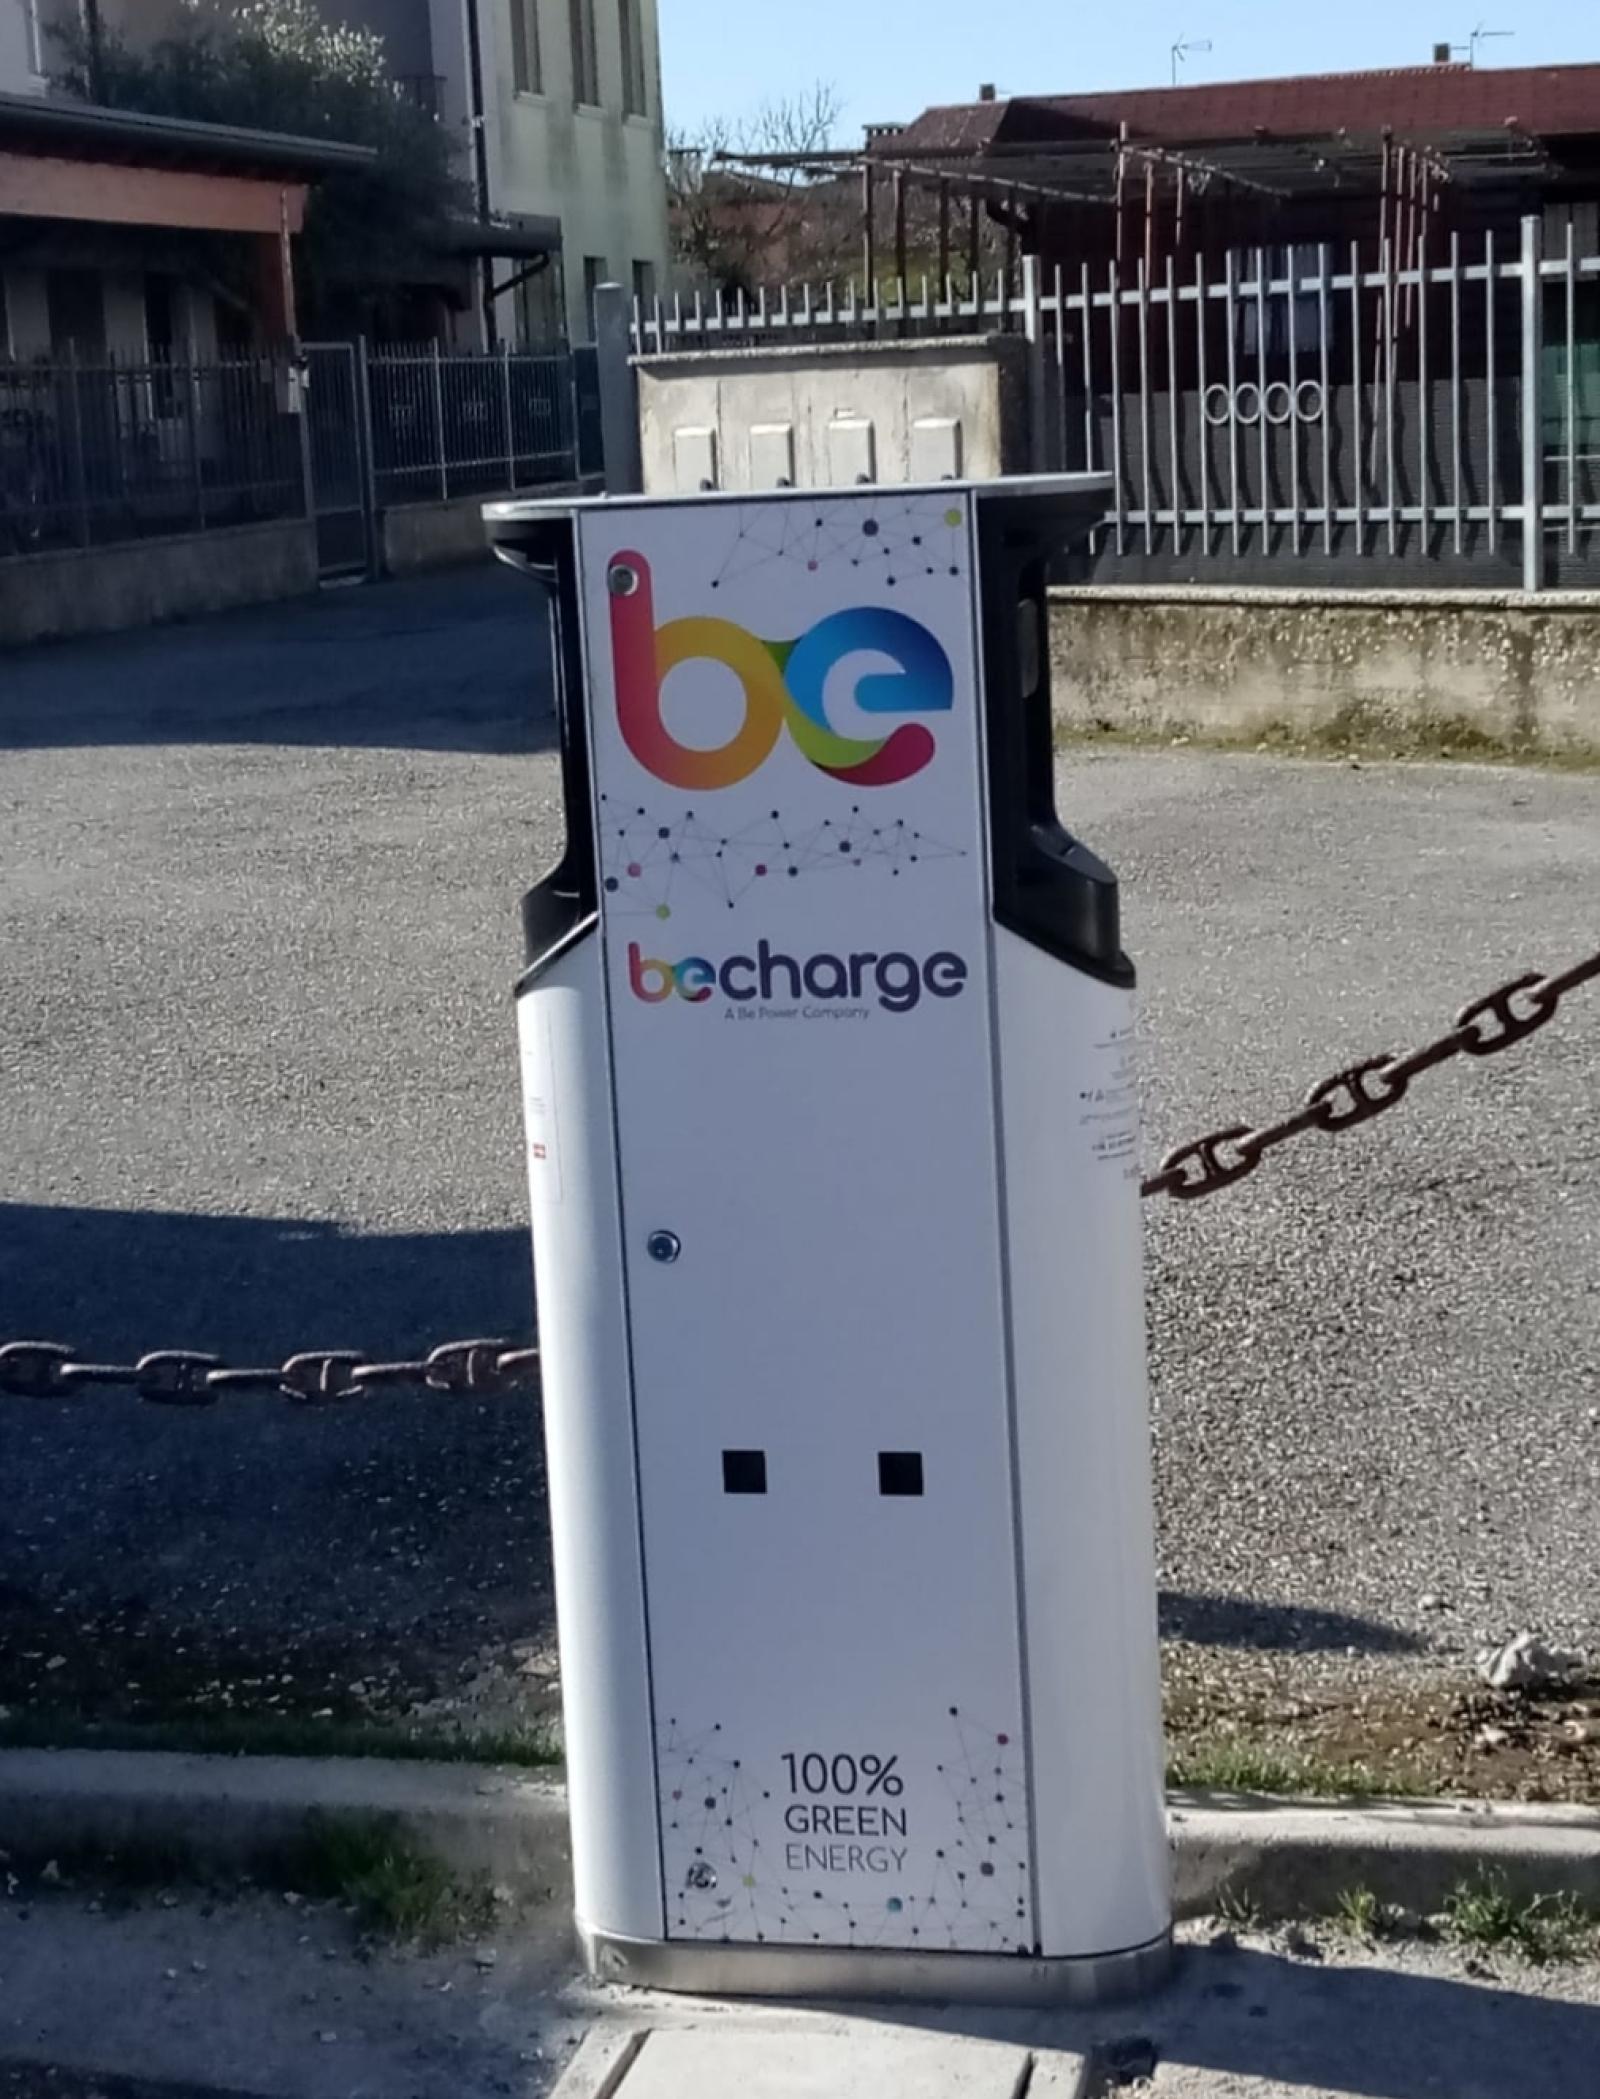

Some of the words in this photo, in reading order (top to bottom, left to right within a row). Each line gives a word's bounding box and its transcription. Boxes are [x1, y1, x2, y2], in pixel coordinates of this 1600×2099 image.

[609, 549, 954, 791] be
[628, 938, 967, 1013] becharge
[724, 1006, 735, 1019] A
[738, 1006, 756, 1019] Be
[758, 1005, 798, 1018] Power
[802, 1005, 871, 1020] Company
[781, 1752, 904, 1796] 100%
[785, 1804, 906, 1836] GREEN
[786, 1843, 908, 1872] ENERGY
